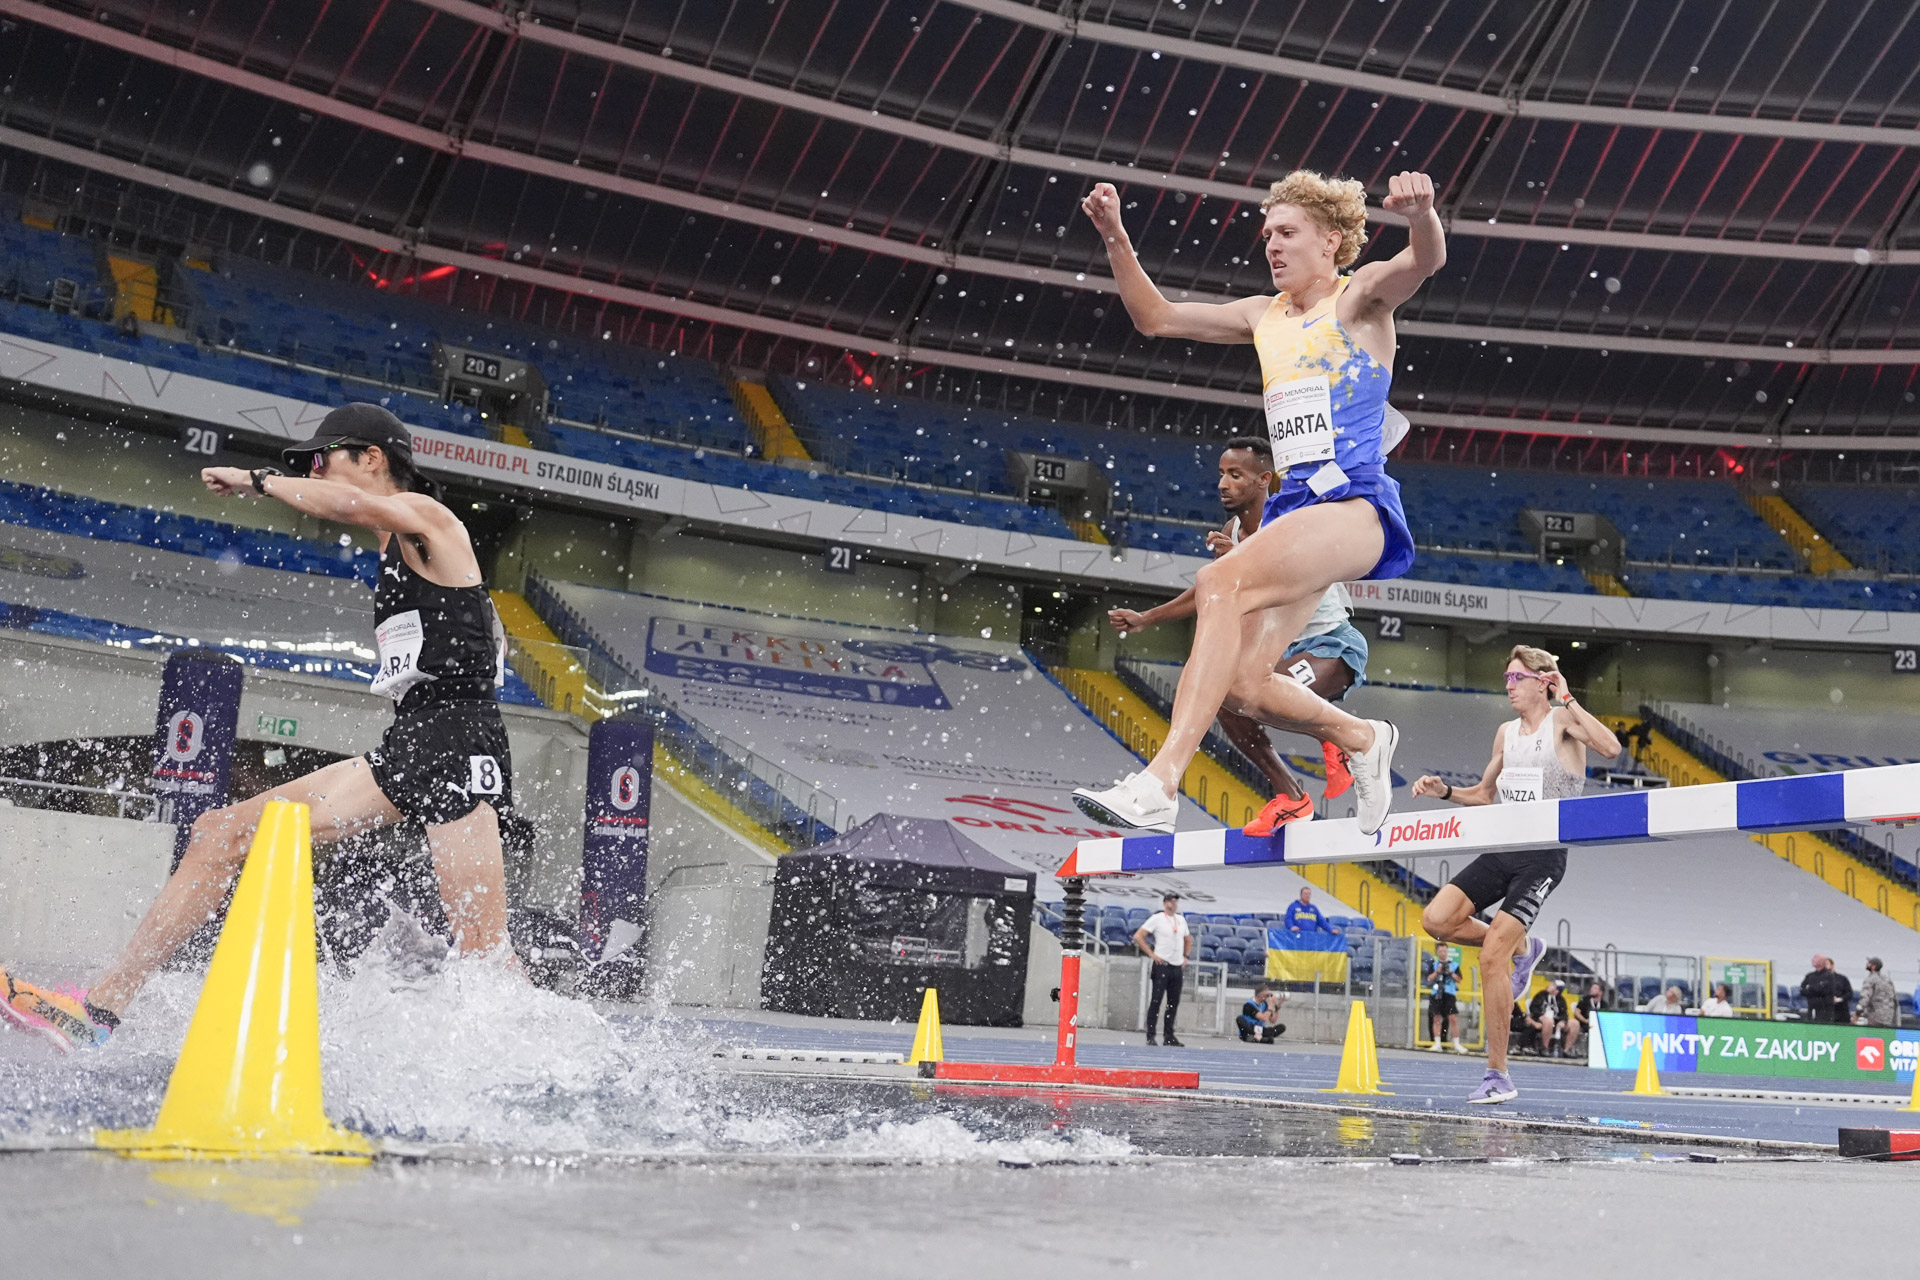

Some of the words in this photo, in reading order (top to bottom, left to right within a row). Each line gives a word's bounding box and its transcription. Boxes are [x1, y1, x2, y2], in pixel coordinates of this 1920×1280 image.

[466, 358, 485, 374] 20
[185, 427, 218, 455] 20
[412, 436, 530, 475] SUPERAUTO.PL
[536, 461, 603, 489] STADION
[607, 472, 660, 500] ŚLĄSKI
[1037, 462, 1052, 476] 21
[830, 546, 850, 569] 21
[1388, 587, 1441, 605] STADION
[1445, 589, 1488, 612] ŚLĄSKI
[1380, 615, 1401, 637] 22
[1895, 649, 1917, 670] 23
[1296, 664, 1313, 686] 11
[480, 758, 496, 791] 8
[1502, 788, 1536, 802] MAZZA
[952, 816, 1125, 838] ORLEN
[1389, 816, 1461, 847] polanik
[1622, 1030, 1715, 1057] PUNKTY
[1720, 1035, 1749, 1058] ZA
[1755, 1038, 1840, 1062] ZAKUPY
